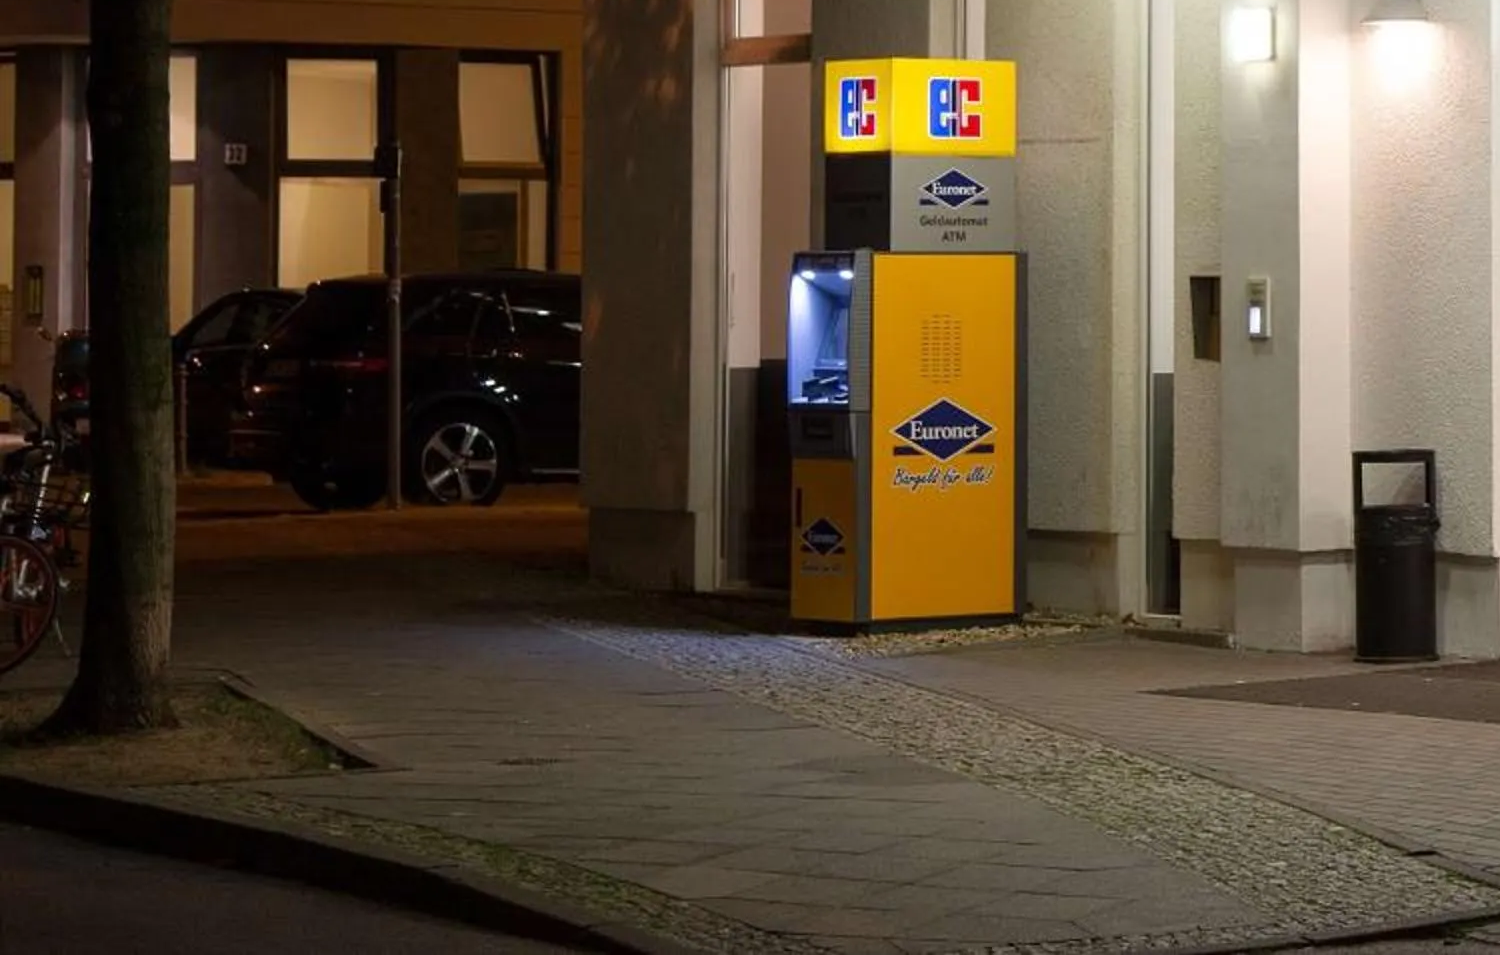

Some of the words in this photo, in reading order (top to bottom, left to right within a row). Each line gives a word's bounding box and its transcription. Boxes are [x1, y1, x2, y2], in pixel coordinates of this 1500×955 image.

[932, 182, 978, 196] Euronet
[919, 215, 988, 228] Geldautomat
[942, 230, 967, 243] ATM
[909, 420, 980, 441] Euronet
[893, 466, 940, 492] Bargeld
